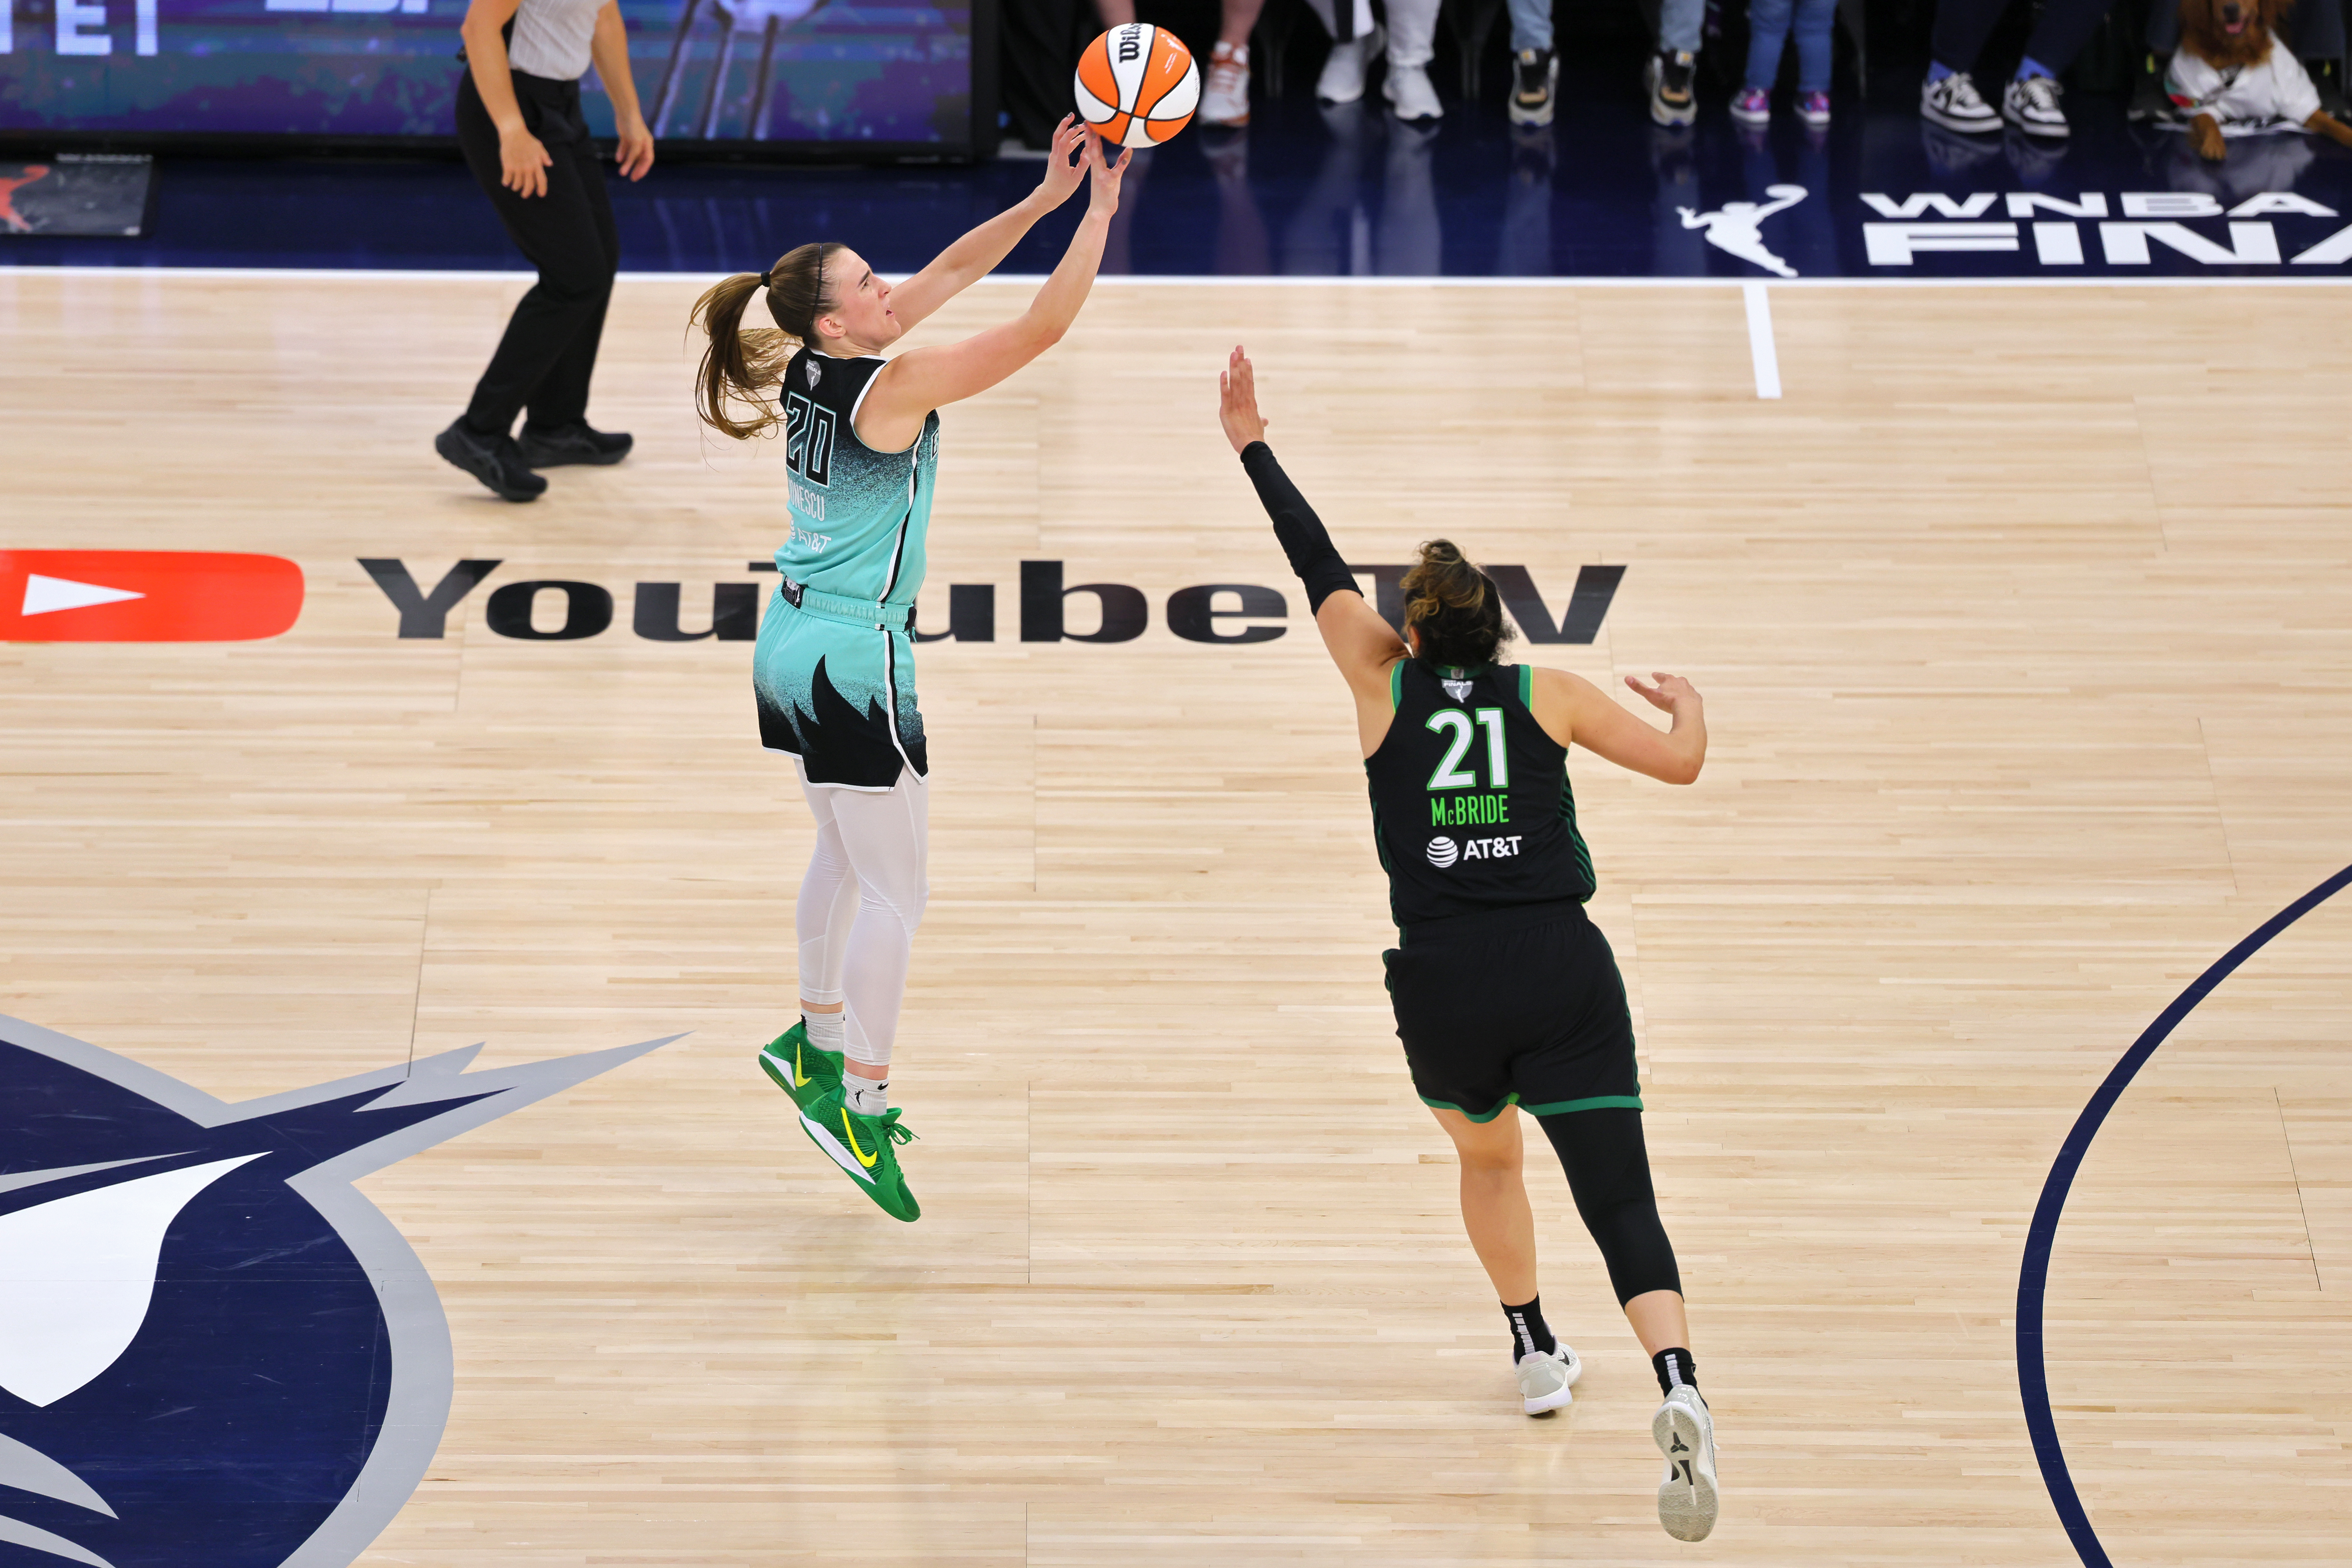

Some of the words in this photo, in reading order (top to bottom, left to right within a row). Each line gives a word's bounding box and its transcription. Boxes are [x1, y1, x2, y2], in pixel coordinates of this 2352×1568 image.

[1859, 192, 2339, 218] WNBA
[806, 364, 821, 375] FINALS
[786, 391, 837, 489] 20
[797, 528, 832, 553] AT&T
[357, 558, 1287, 644] Youube
[1425, 708, 1508, 791] 21
[1431, 794, 1509, 827] McBRIDE
[1463, 836, 1522, 860] AT&T
